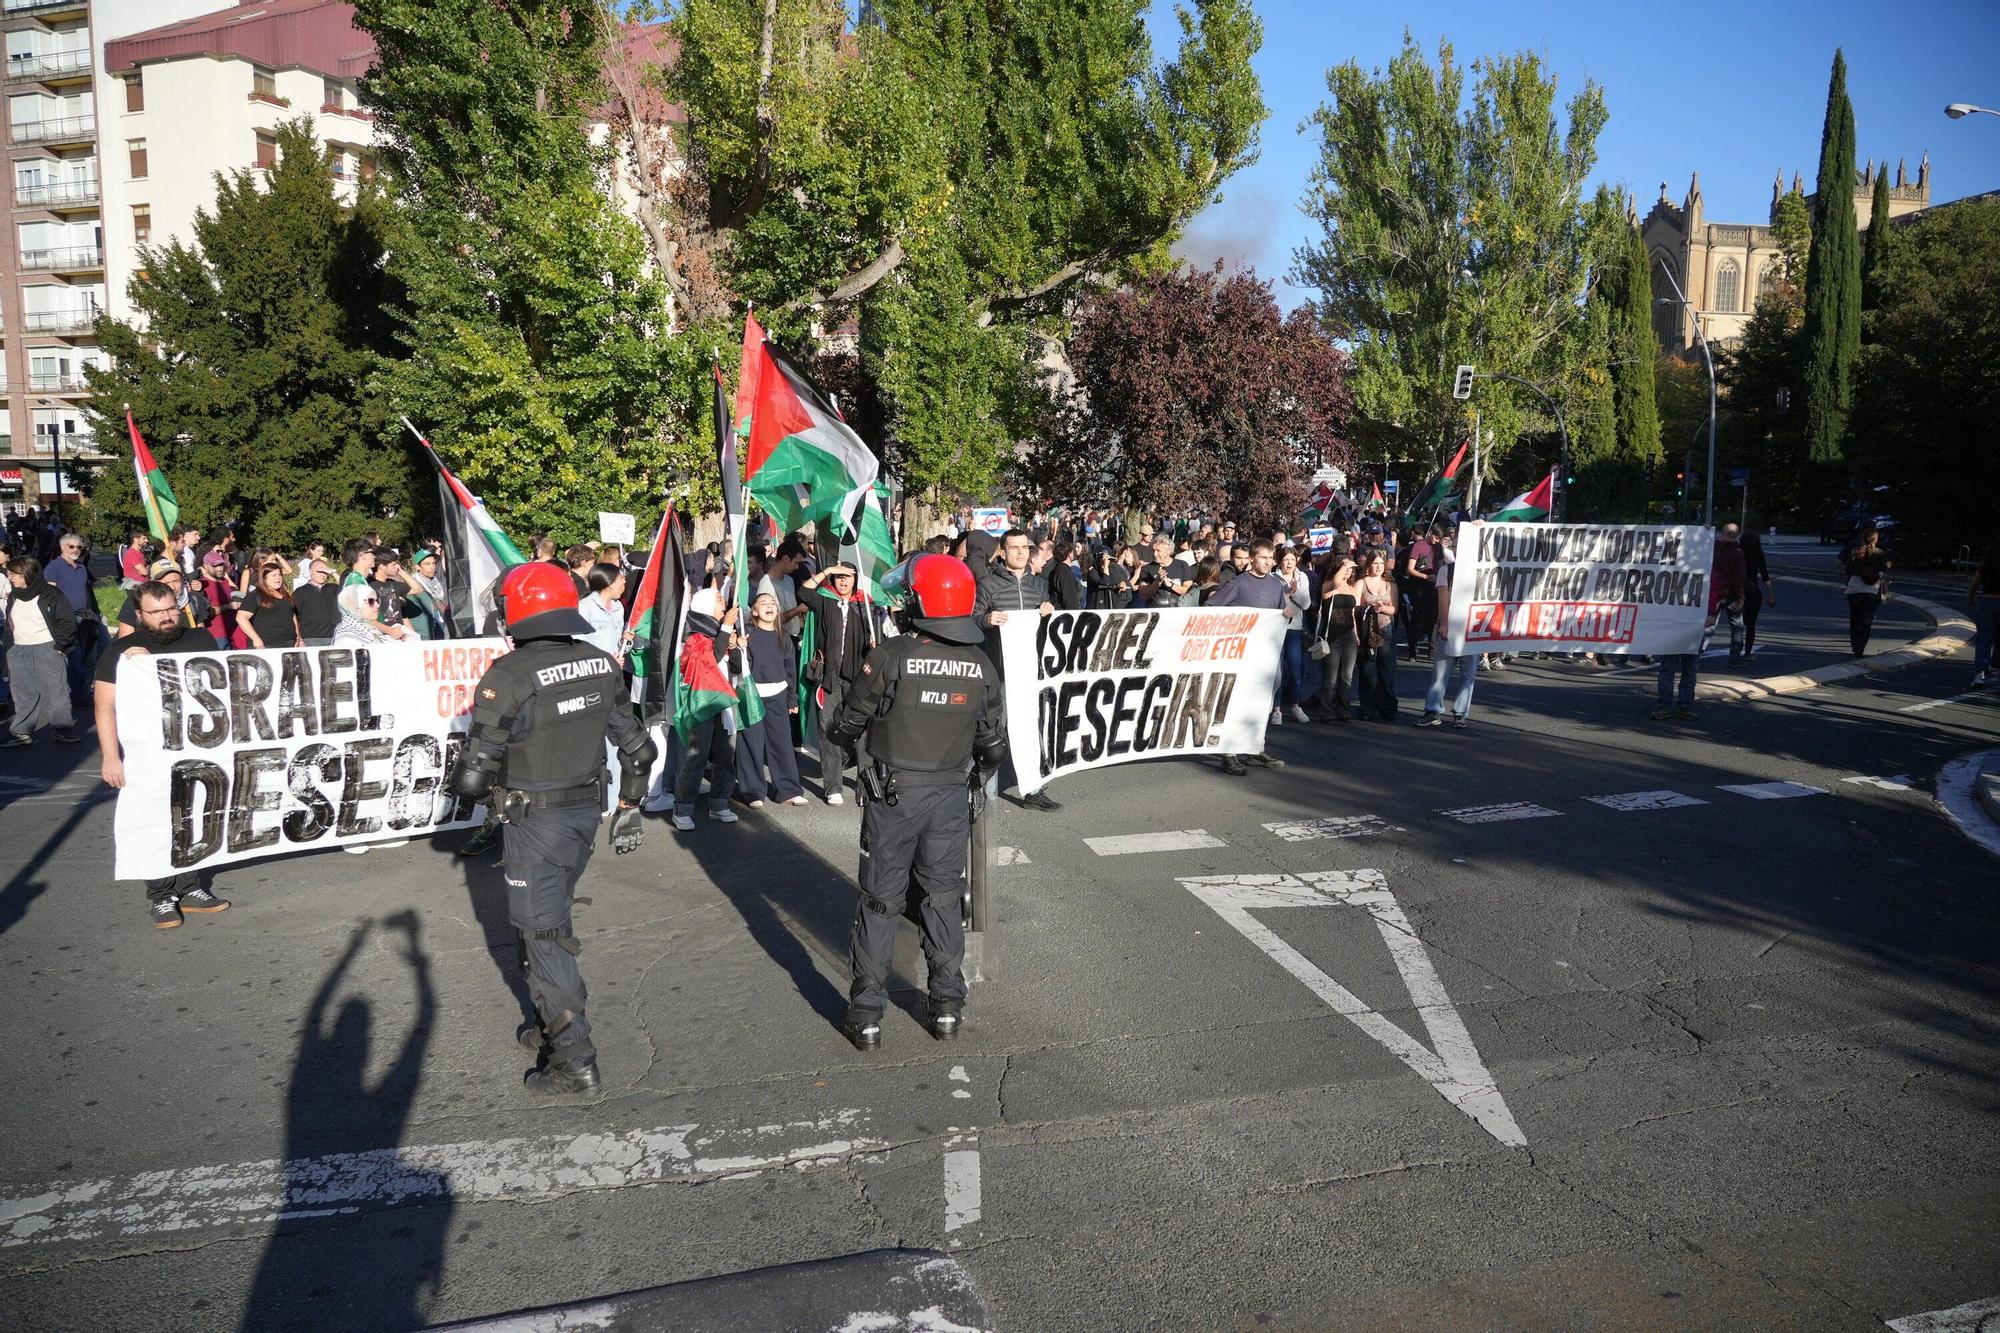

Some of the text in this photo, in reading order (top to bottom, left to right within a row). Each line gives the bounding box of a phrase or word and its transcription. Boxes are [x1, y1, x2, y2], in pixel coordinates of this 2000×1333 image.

[1477, 526, 1681, 565] KOLONIZAZIOAREN
[1473, 566, 1704, 607] KONTRAKO BORROKA
[1468, 604, 1634, 641] EZ DA BUKATU!
[1036, 612, 1160, 680] ISRAEL
[1210, 636, 1247, 661] ETEN
[537, 658, 612, 687] ERTZAINTZA
[907, 659, 983, 679] ERTZAINTZA
[157, 649, 395, 750] ISRAEL
[921, 691, 948, 705] M7L9
[1038, 672, 1237, 778] DESEGIN!
